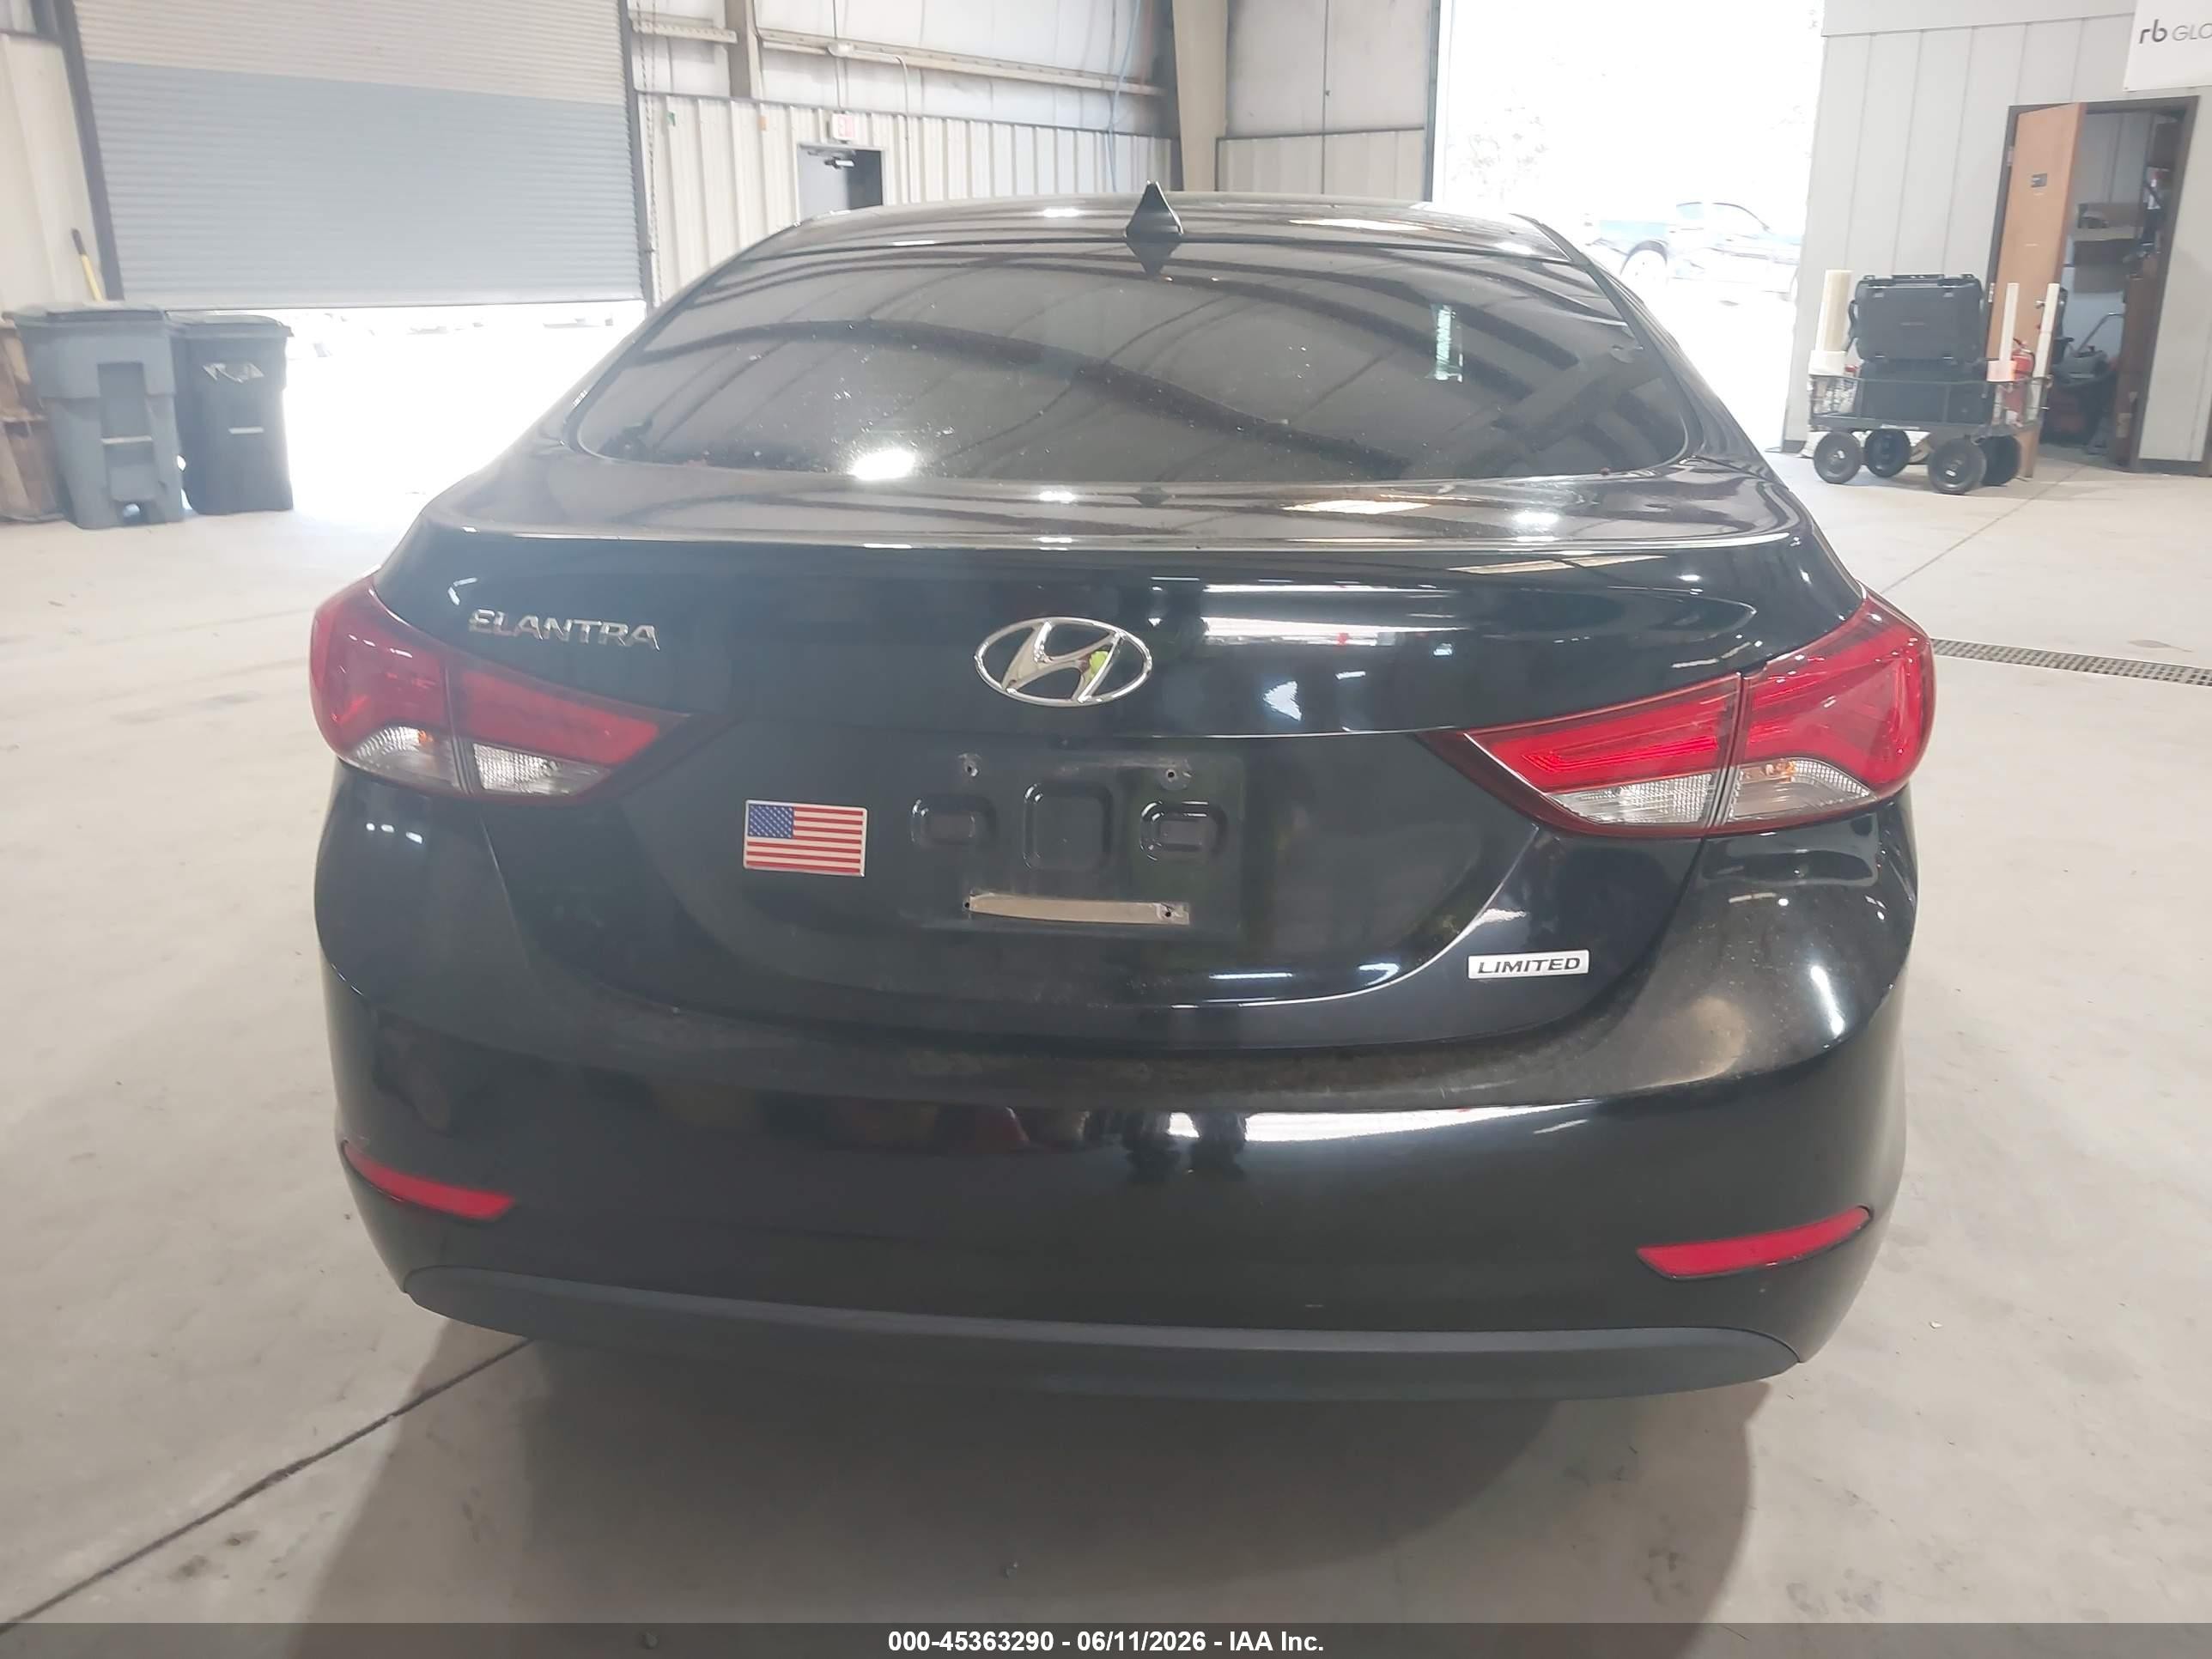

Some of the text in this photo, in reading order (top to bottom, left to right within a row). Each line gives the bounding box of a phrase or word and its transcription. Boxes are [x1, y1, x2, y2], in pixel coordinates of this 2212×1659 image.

[2139, 19, 2167, 44] rb
[469, 609, 659, 651] ELANTRA
[1478, 957, 1580, 974] LIMITED
